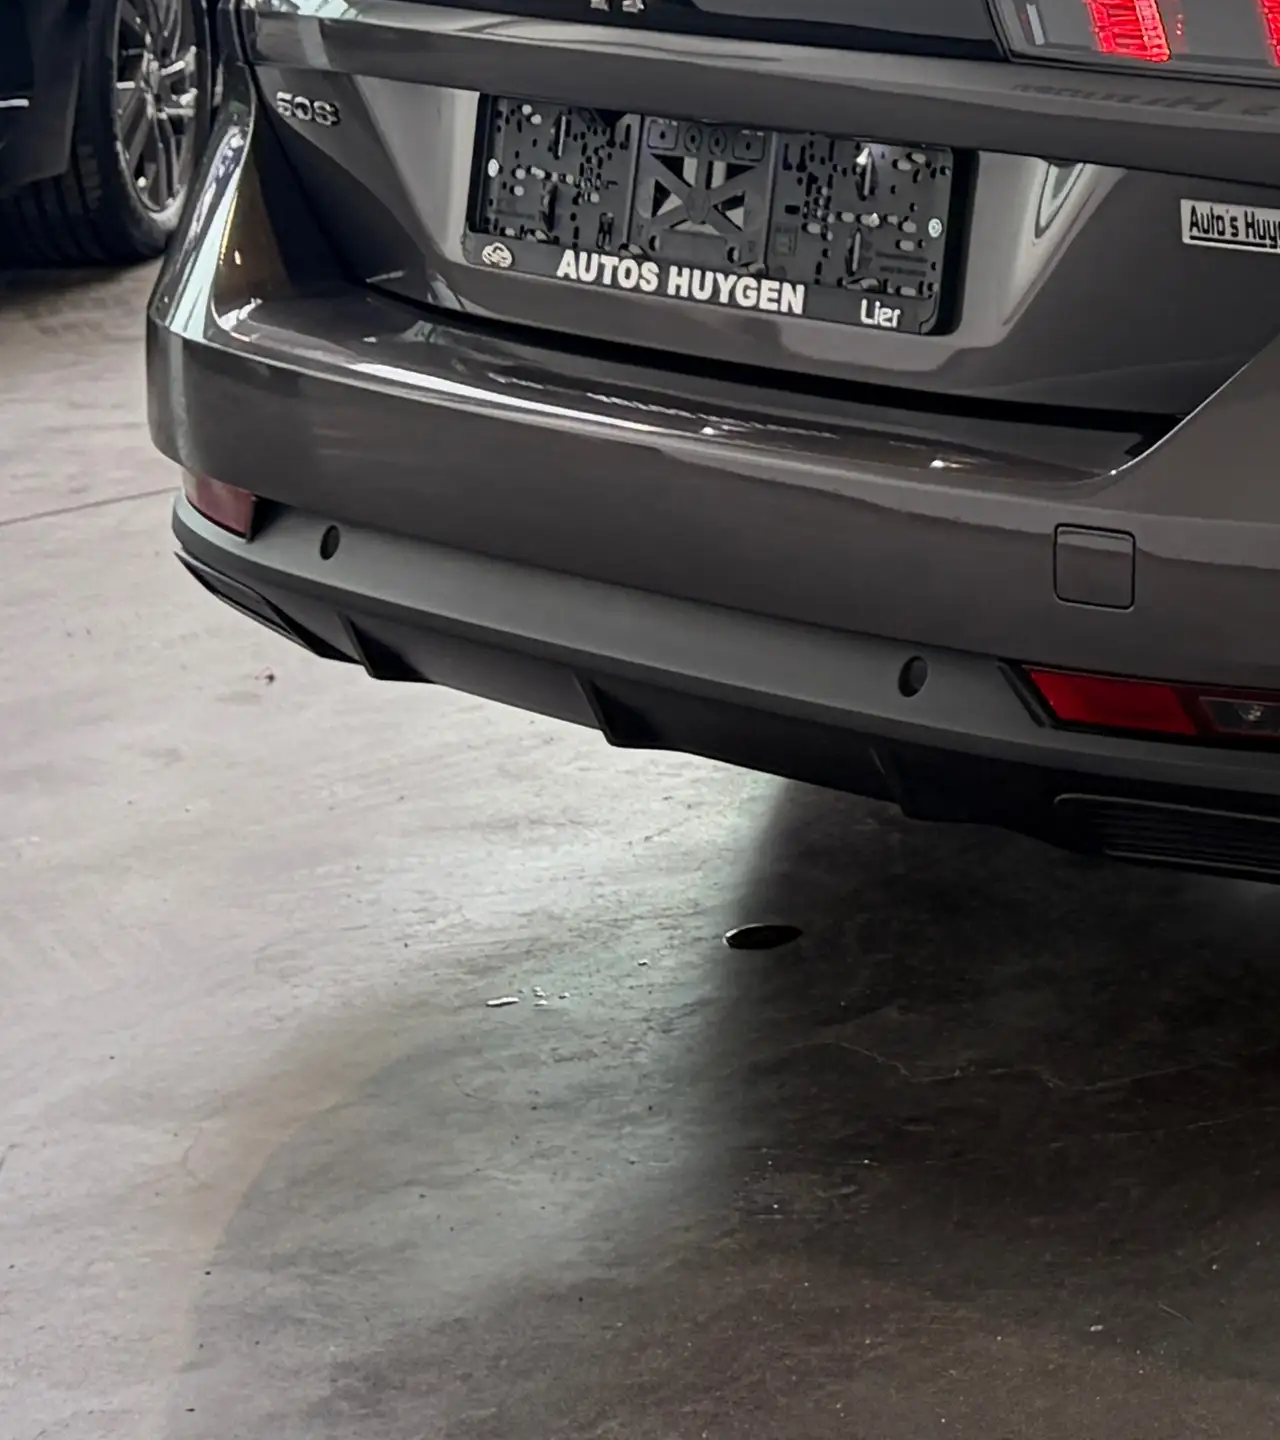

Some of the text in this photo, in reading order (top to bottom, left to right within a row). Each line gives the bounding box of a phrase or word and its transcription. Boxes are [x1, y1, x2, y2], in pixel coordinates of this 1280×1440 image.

[276, 91, 340, 126] 508
[1189, 204, 1240, 238] Auto's
[557, 249, 805, 313] AUTOS HUYGEN
[860, 298, 901, 329] Lier
